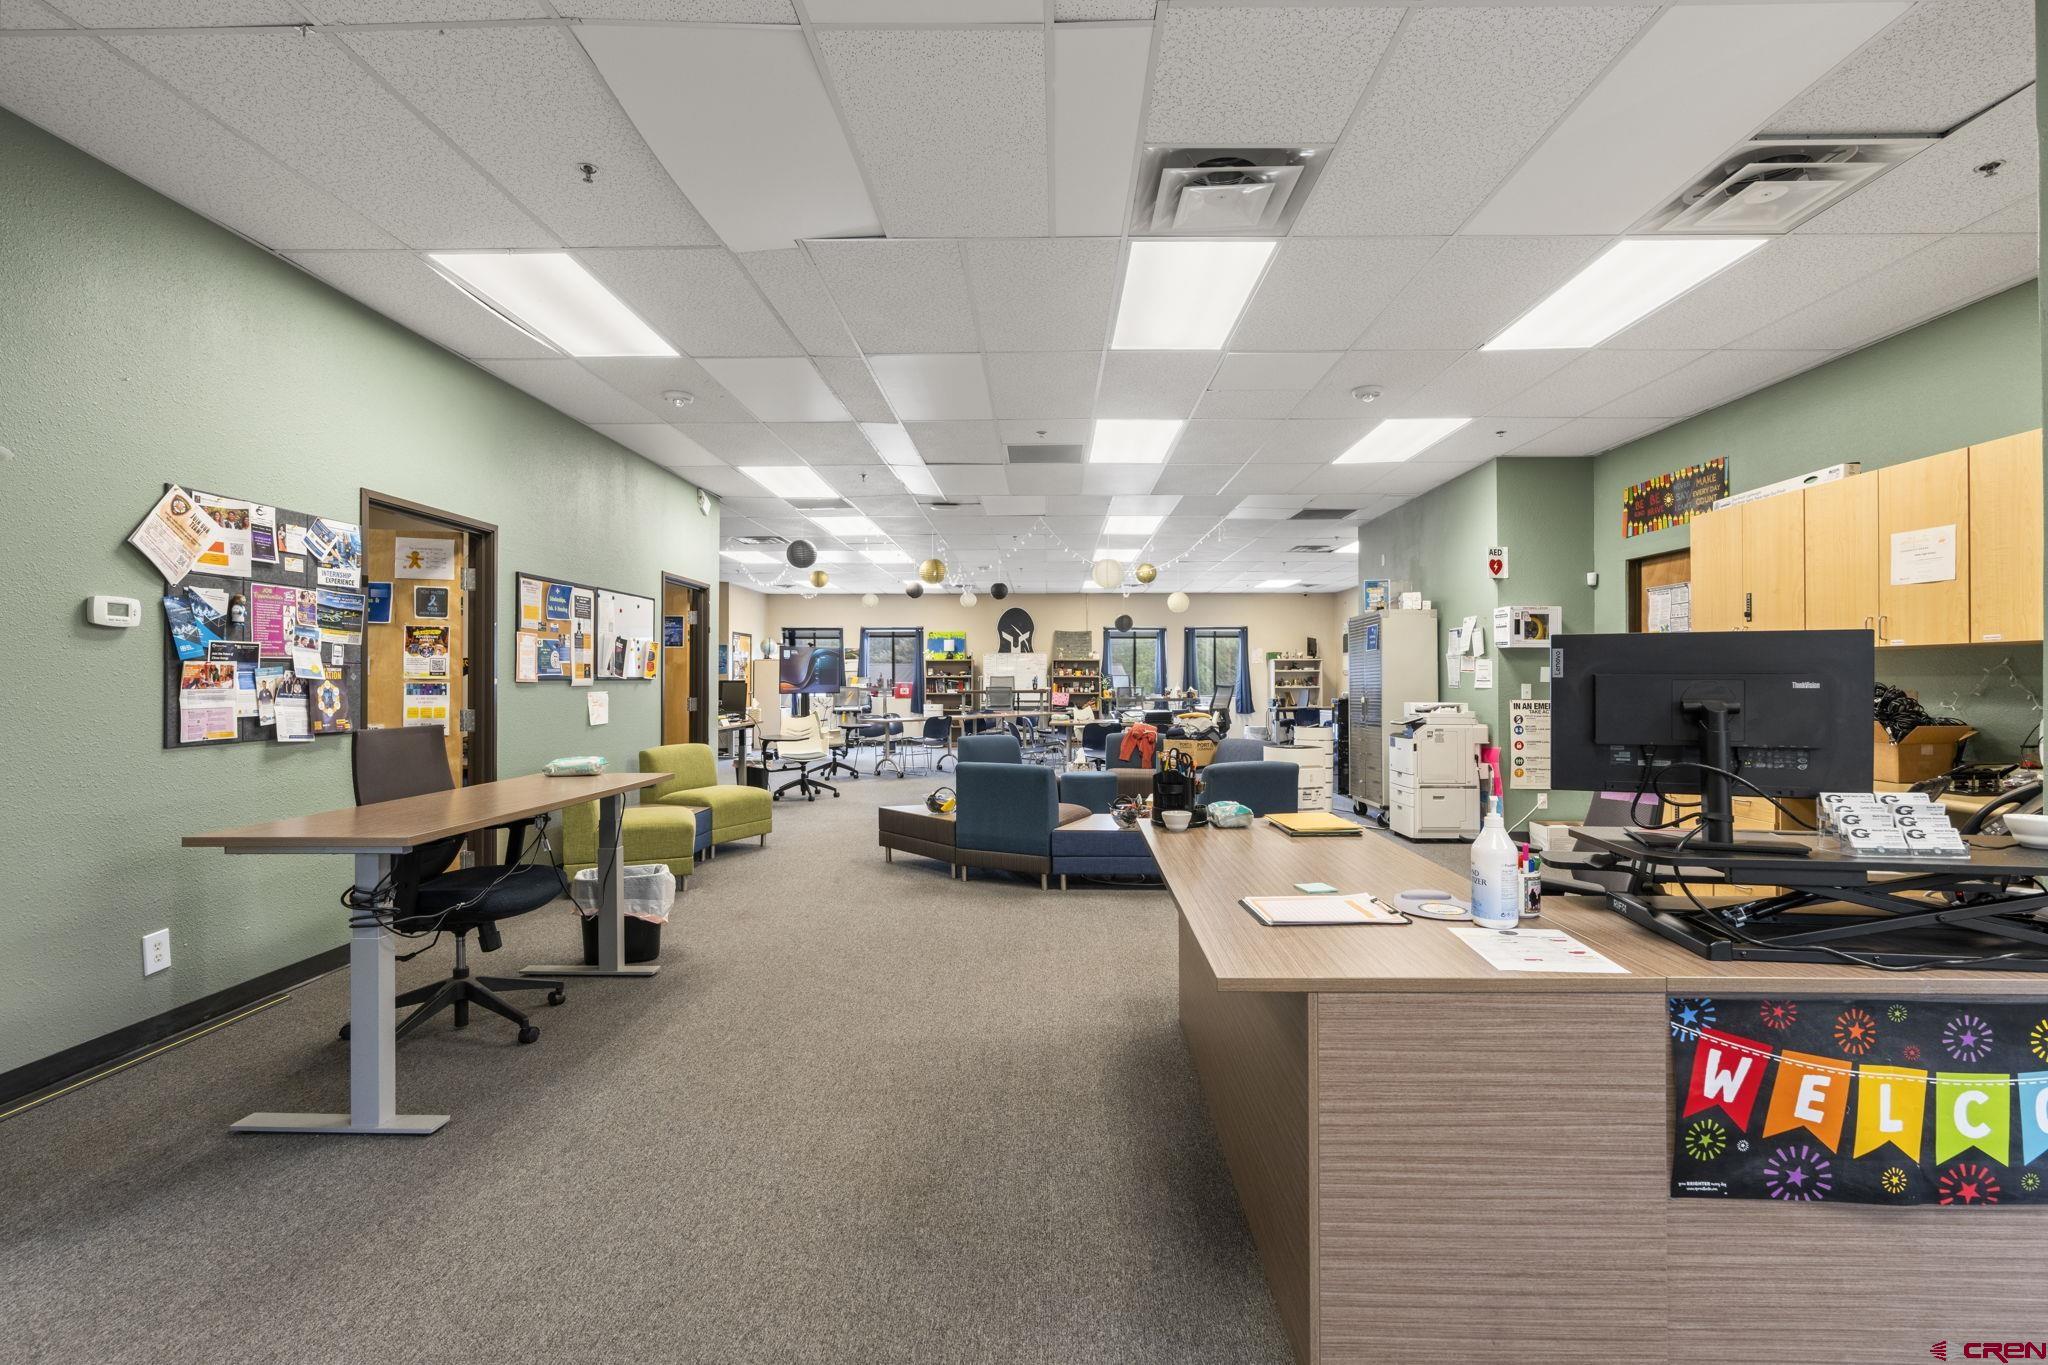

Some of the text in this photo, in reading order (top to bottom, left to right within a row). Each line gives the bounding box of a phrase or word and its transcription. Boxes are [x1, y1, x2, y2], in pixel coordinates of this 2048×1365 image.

[1696, 474, 1716, 486] MAKE
[1693, 484, 1721, 497] EVERY DAY
[1649, 493, 1660, 505] BE
[1695, 494, 1718, 505] COUNT
[321, 570, 352, 579] INTERNSHIP
[325, 578, 355, 586] EXPERIENCE
[1791, 681, 1820, 689] ThinkVision
